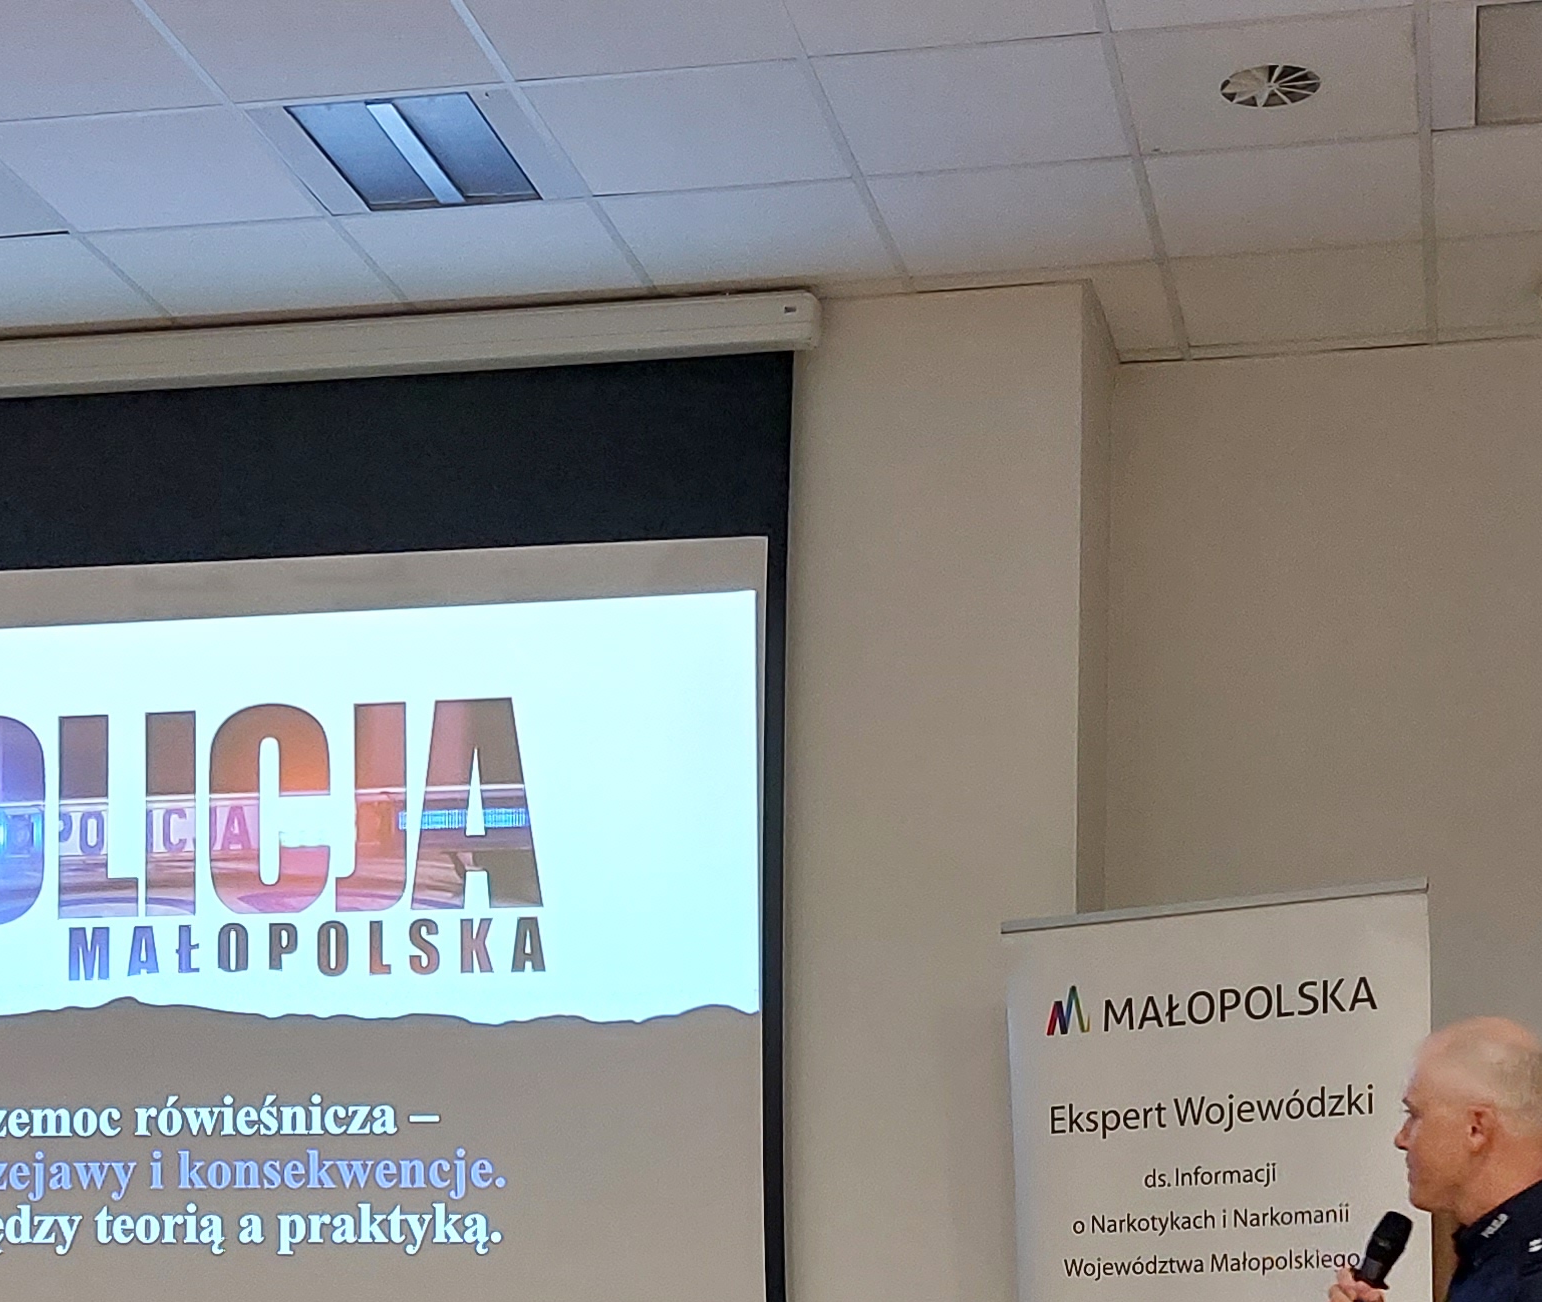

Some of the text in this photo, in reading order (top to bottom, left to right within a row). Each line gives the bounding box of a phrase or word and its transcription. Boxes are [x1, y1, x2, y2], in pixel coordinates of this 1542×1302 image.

[67, 916, 546, 982] MAŁOPOLSKA
[1103, 976, 1378, 1032] MAŁOPOLSKA
[134, 1094, 398, 1136] rówieśnicza
[1050, 1084, 1374, 1140] Ekspert Wojewódzki
[149, 1150, 164, 1190] i
[177, 1149, 506, 1200] konsekwencje.
[1144, 1162, 1277, 1189] ds. Informacji
[95, 1204, 226, 1255] teorią
[238, 1214, 265, 1245] a
[277, 1203, 503, 1255] praktyką.
[1072, 1204, 1350, 1238] o Narkotykach i Narkomanii
[1063, 1248, 1360, 1282] Województwa Małopolskiego
